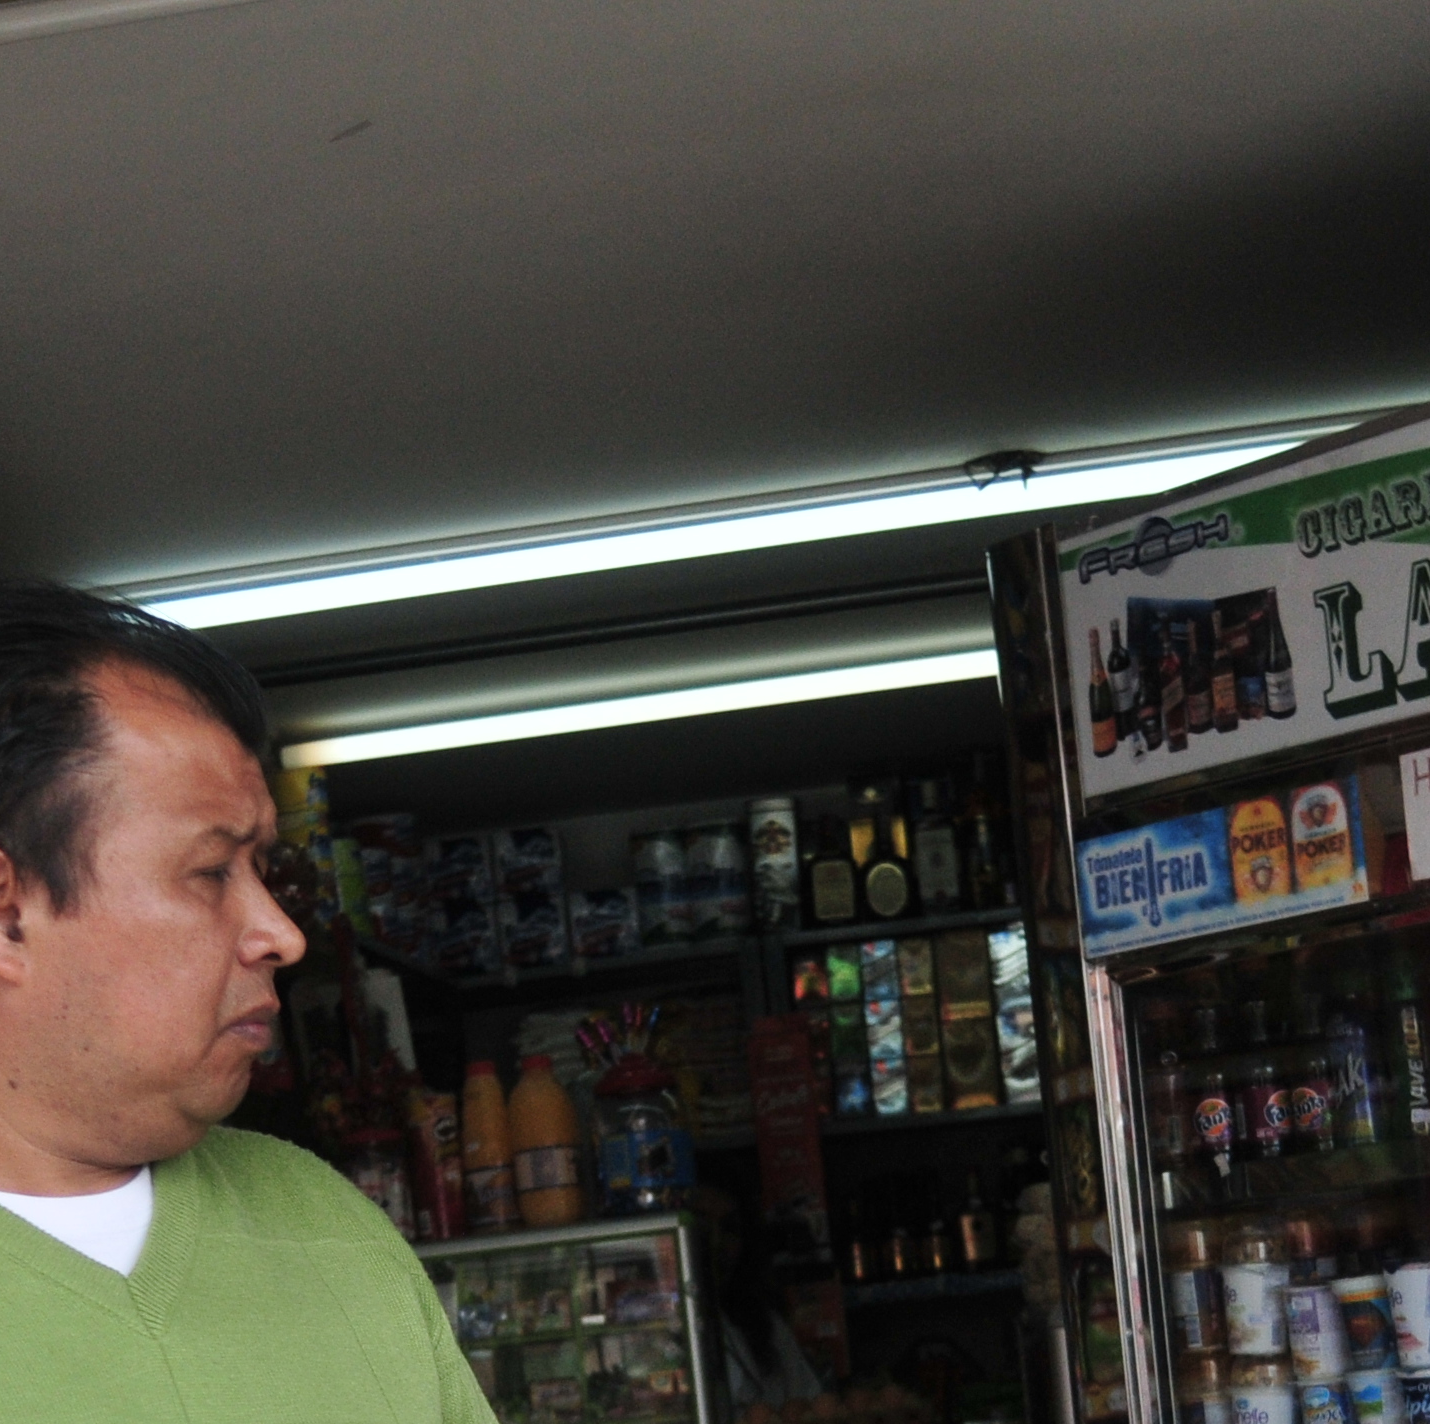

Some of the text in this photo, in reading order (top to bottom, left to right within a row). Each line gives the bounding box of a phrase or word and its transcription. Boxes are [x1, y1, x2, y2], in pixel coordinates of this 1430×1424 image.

[1231, 826, 1287, 855] POKER
[1296, 832, 1347, 859] POKER
[1086, 847, 1143, 876] Tómatela
[1094, 866, 1148, 910] BIEN
